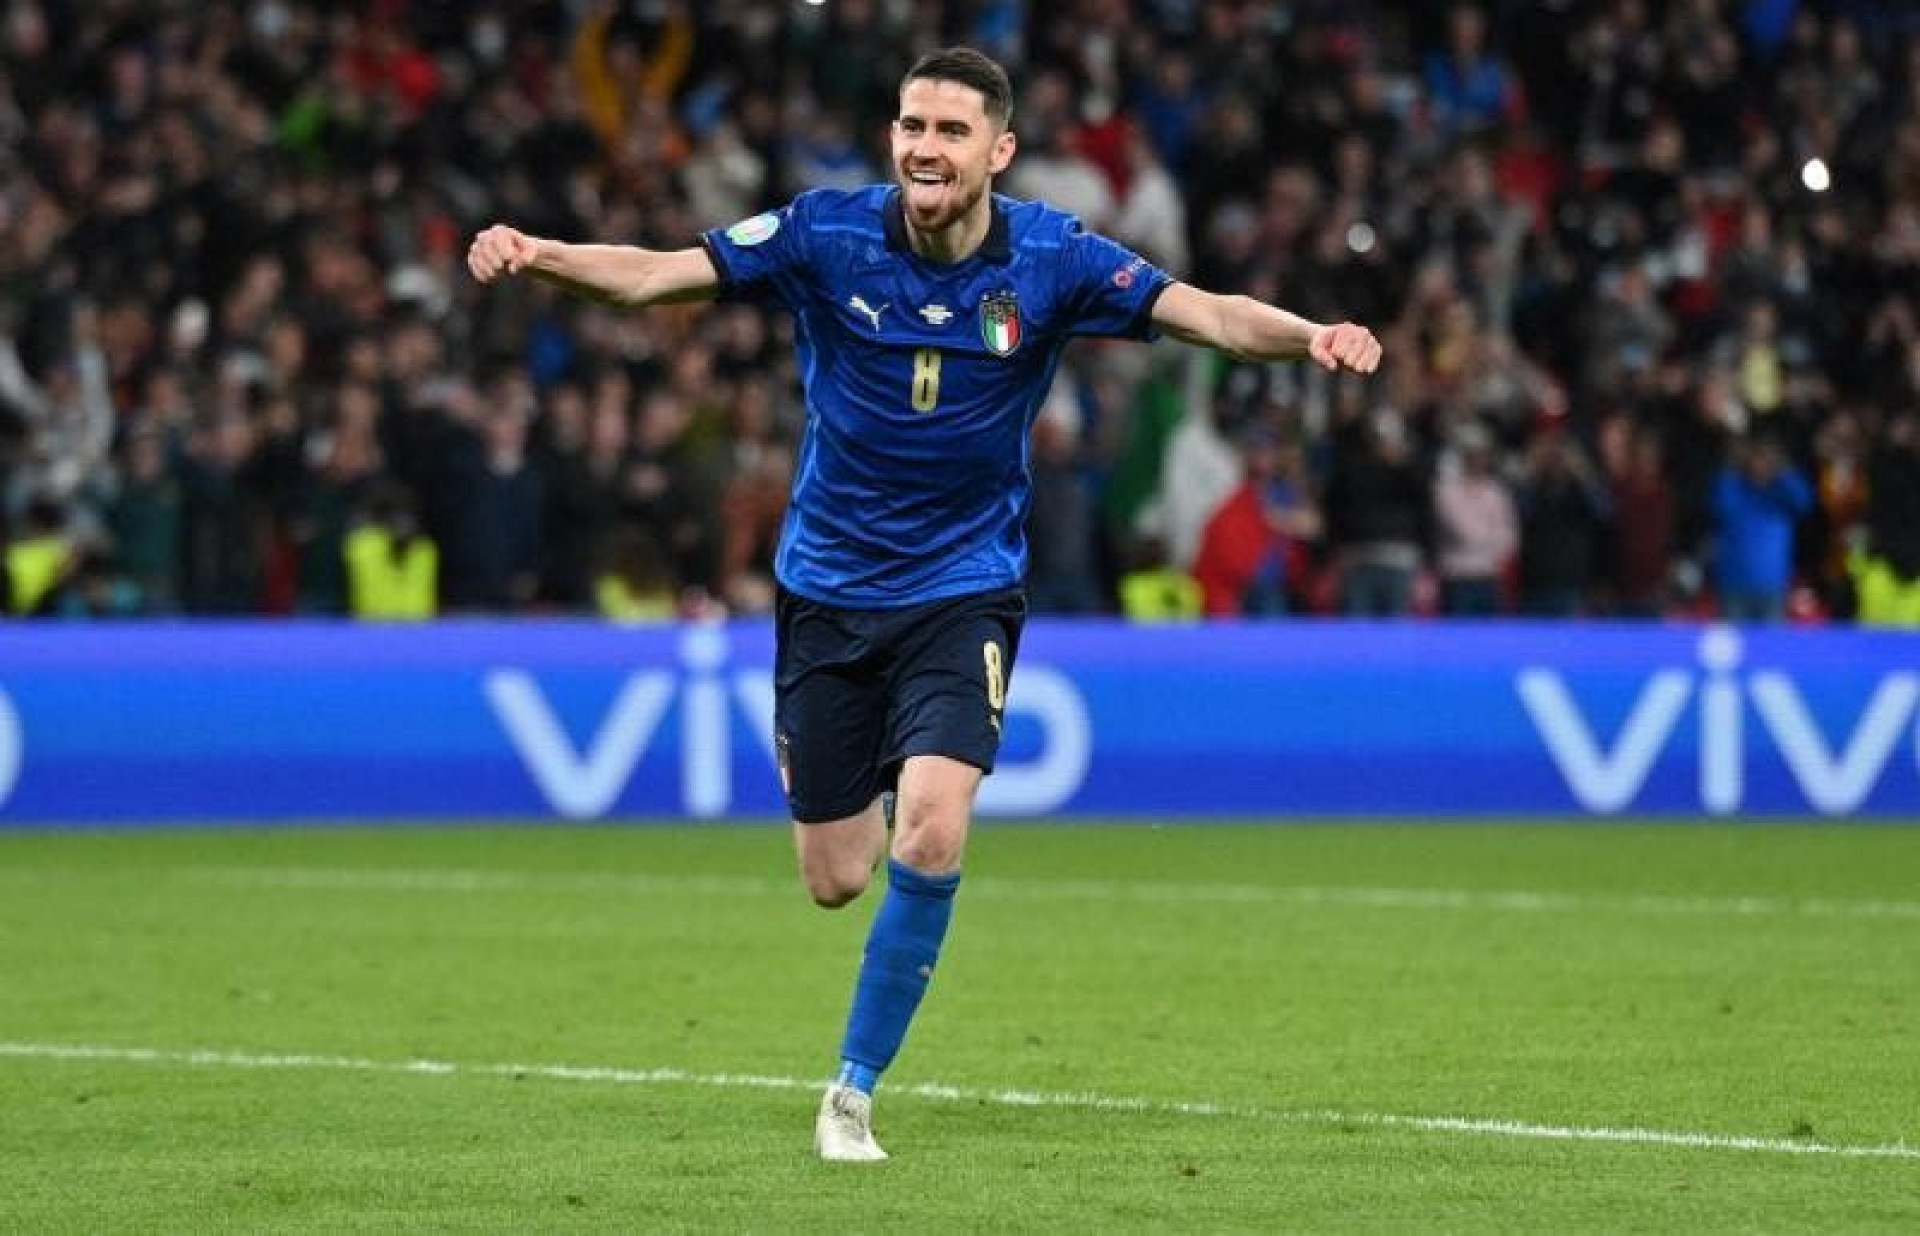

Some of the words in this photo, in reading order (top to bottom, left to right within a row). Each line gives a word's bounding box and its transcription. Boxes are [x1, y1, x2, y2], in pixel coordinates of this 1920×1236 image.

[912, 349, 941, 412] 8
[485, 625, 1092, 817] vio
[984, 641, 1004, 710] 8
[1515, 625, 1920, 814] viv
